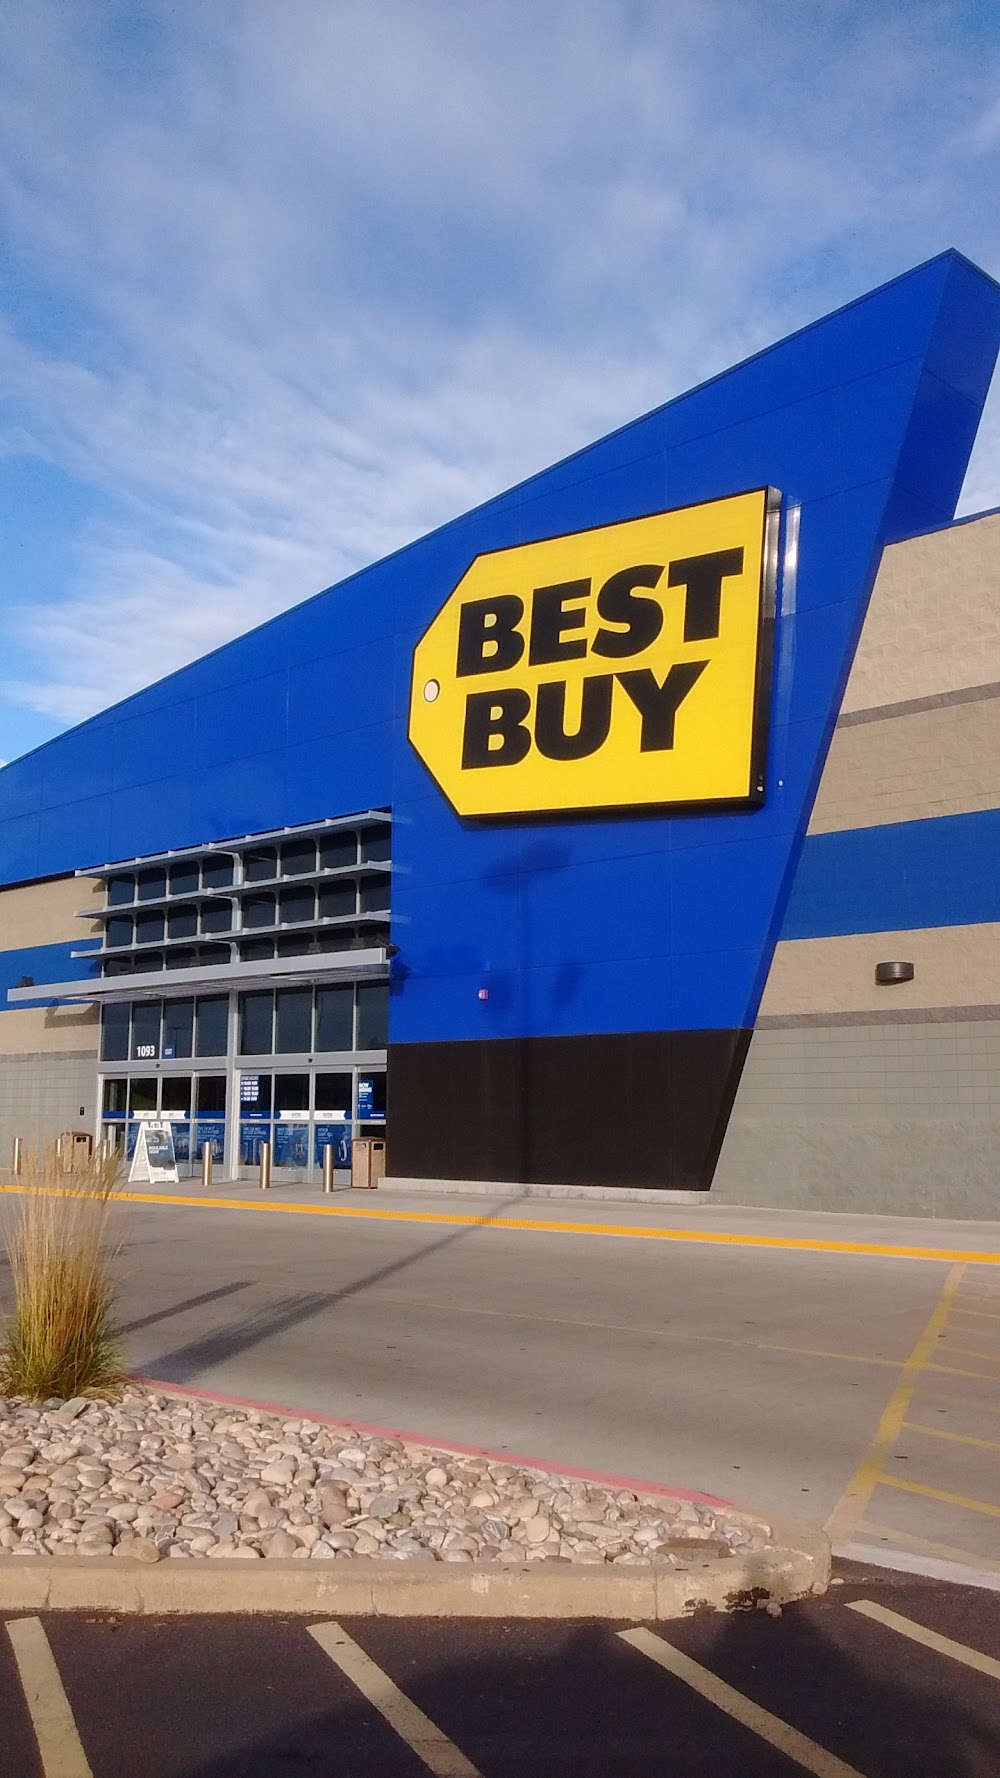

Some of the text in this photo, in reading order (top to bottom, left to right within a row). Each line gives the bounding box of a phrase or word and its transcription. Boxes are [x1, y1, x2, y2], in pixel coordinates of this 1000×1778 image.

[456, 546, 745, 678] BEST
[461, 659, 711, 770] BUY
[136, 1045, 155, 1057] 1093
